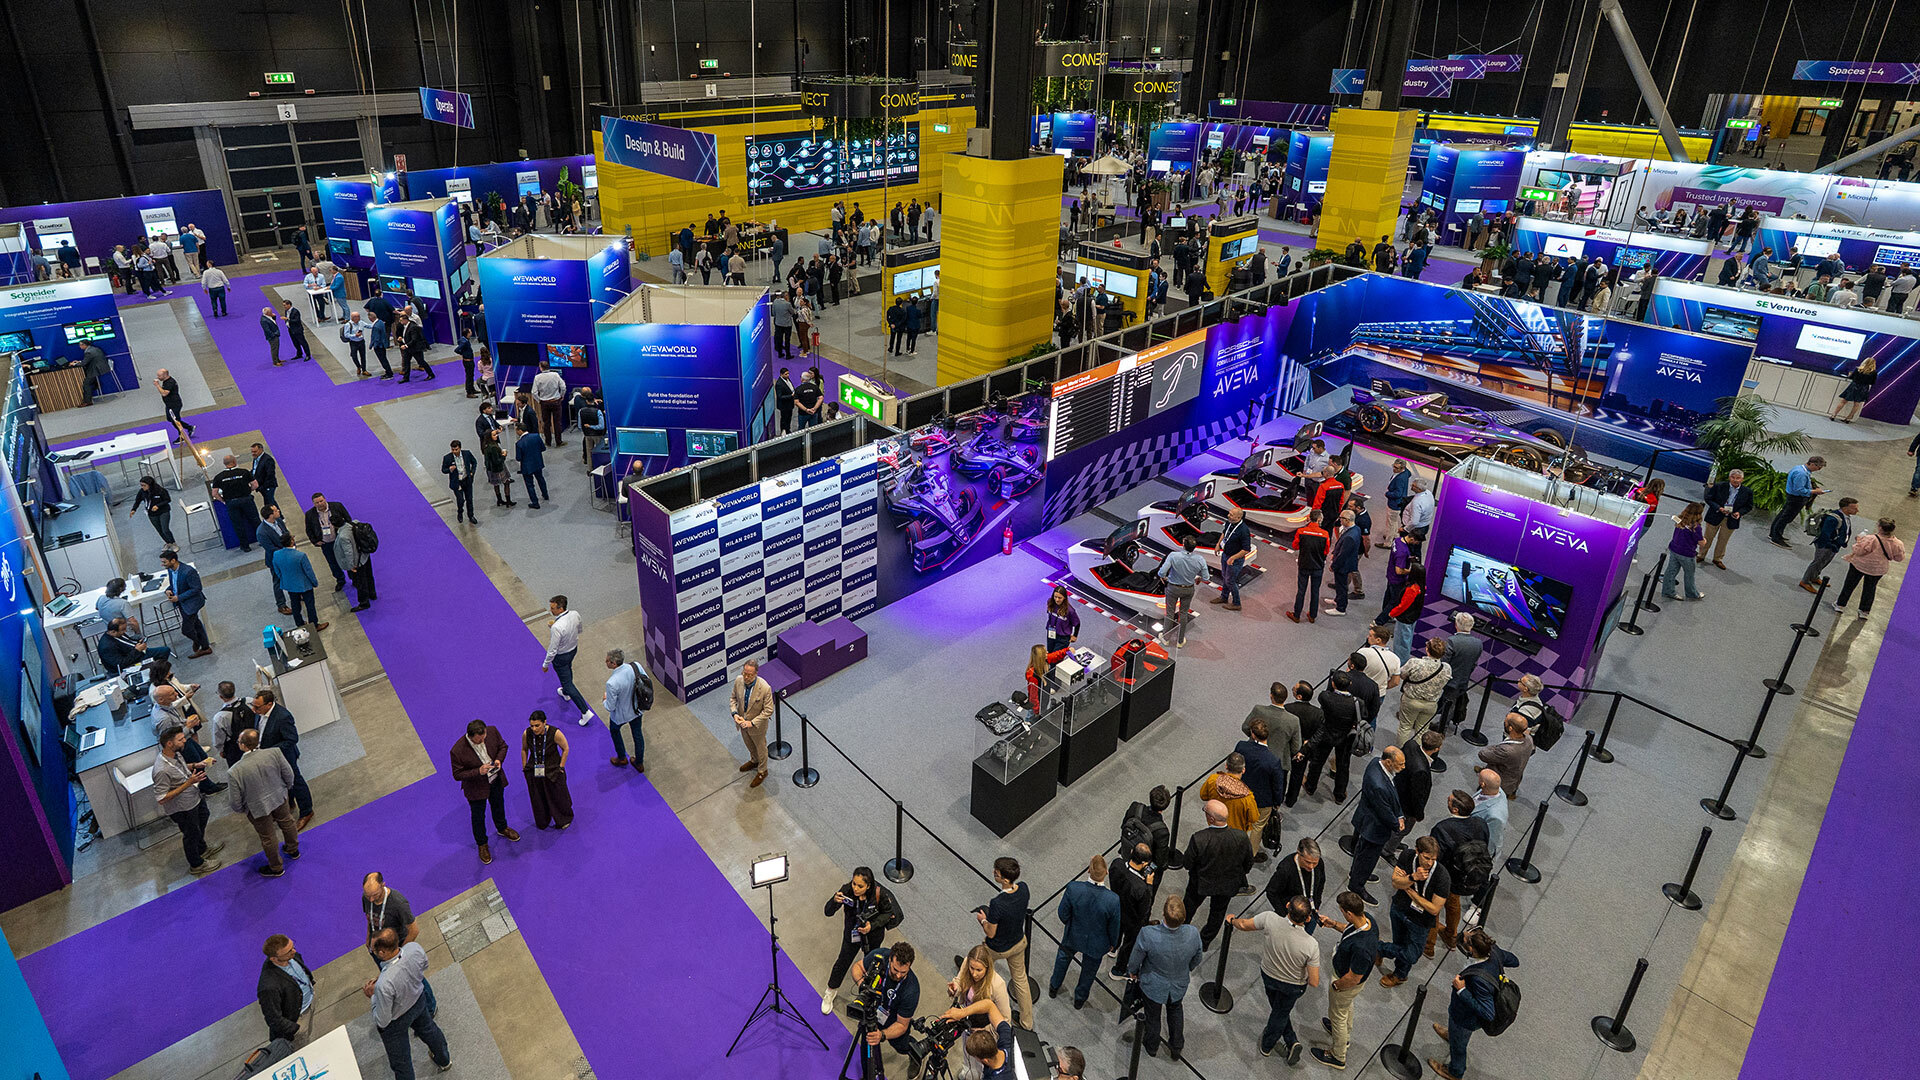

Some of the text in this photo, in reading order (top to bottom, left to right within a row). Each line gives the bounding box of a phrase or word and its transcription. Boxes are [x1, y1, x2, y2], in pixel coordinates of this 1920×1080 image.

[952, 54, 978, 68] CONNE
[1828, 66, 1865, 77] Spaces
[1404, 78, 1428, 88] dustry
[435, 98, 455, 114] Operate
[284, 110, 291, 118] 3
[625, 134, 686, 161] Design & Build
[1684, 190, 1715, 202] Trusted
[1848, 192, 1878, 202] Microsoft
[10, 288, 56, 302] Schneider
[1754, 300, 1818, 317] SE Ventures
[641, 346, 697, 354] AVEVAWORLD
[1217, 336, 1260, 356] PORSCHE
[1213, 364, 1258, 398] AVEVA
[1656, 366, 1702, 384] AVEVA
[1412, 395, 1431, 404] TDK
[807, 470, 823, 480] MILAN
[842, 469, 875, 486] AVEVAWORLD
[719, 492, 759, 510] AVEVAWORLD
[767, 502, 784, 512] MILAN
[695, 508, 714, 518] AVEVA
[805, 500, 839, 518] AVEVAWORLD
[1466, 499, 1516, 518] PORSCHE
[742, 512, 759, 522] AVEVA
[674, 527, 716, 547] AVEVAWORLD
[725, 536, 743, 548] MILAN
[766, 533, 802, 552] AVEVAWORLD
[1530, 526, 1589, 553] AVEVA
[698, 547, 717, 558] AVEVA
[640, 552, 669, 584] AVEVA
[682, 573, 700, 584] MILAN
[724, 567, 762, 587] AVEVAWORLD
[770, 575, 786, 586] MILAN
[807, 570, 840, 588] AVEVAWORLD
[701, 586, 719, 596] AVEVA
[681, 603, 721, 624] AVEVAWORLD
[730, 610, 747, 622] MILAN
[768, 603, 803, 623] AVEVAWORLD
[688, 648, 705, 660] MILAN
[729, 638, 765, 659] AVEVAWORLD
[849, 644, 855, 652] 2
[687, 674, 726, 698] AVEVAWORLD
[782, 689, 787, 697] 3
